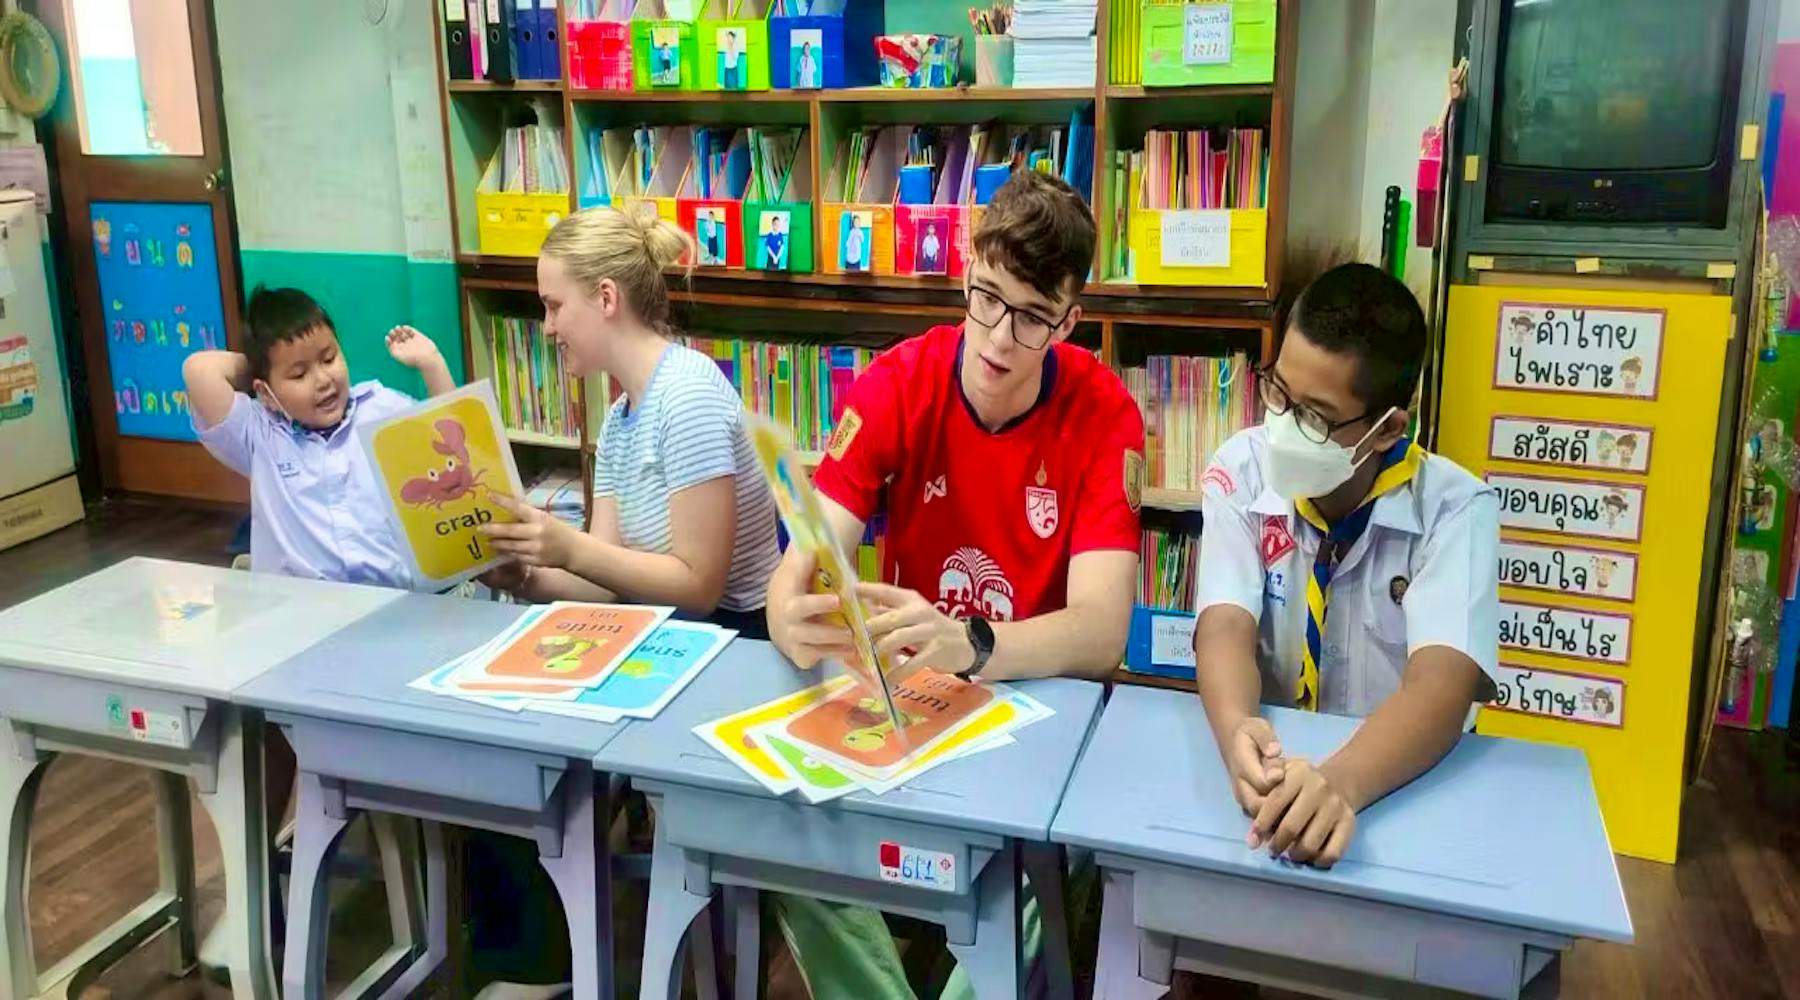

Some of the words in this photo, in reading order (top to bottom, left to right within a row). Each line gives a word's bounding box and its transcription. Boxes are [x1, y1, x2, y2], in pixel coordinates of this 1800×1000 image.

[1536, 310, 1637, 350] คำไทย
[1510, 346, 1614, 389] ไพเราะ
[1514, 424, 1590, 463] สวัสดี
[435, 507, 492, 536] crab
[1494, 487, 1599, 531] ขอบคุณ
[556, 621, 625, 635] turtle
[1498, 609, 1617, 657] ม่เป็นไร
[638, 644, 688, 659] sna
[1496, 672, 1577, 716] อโทษ
